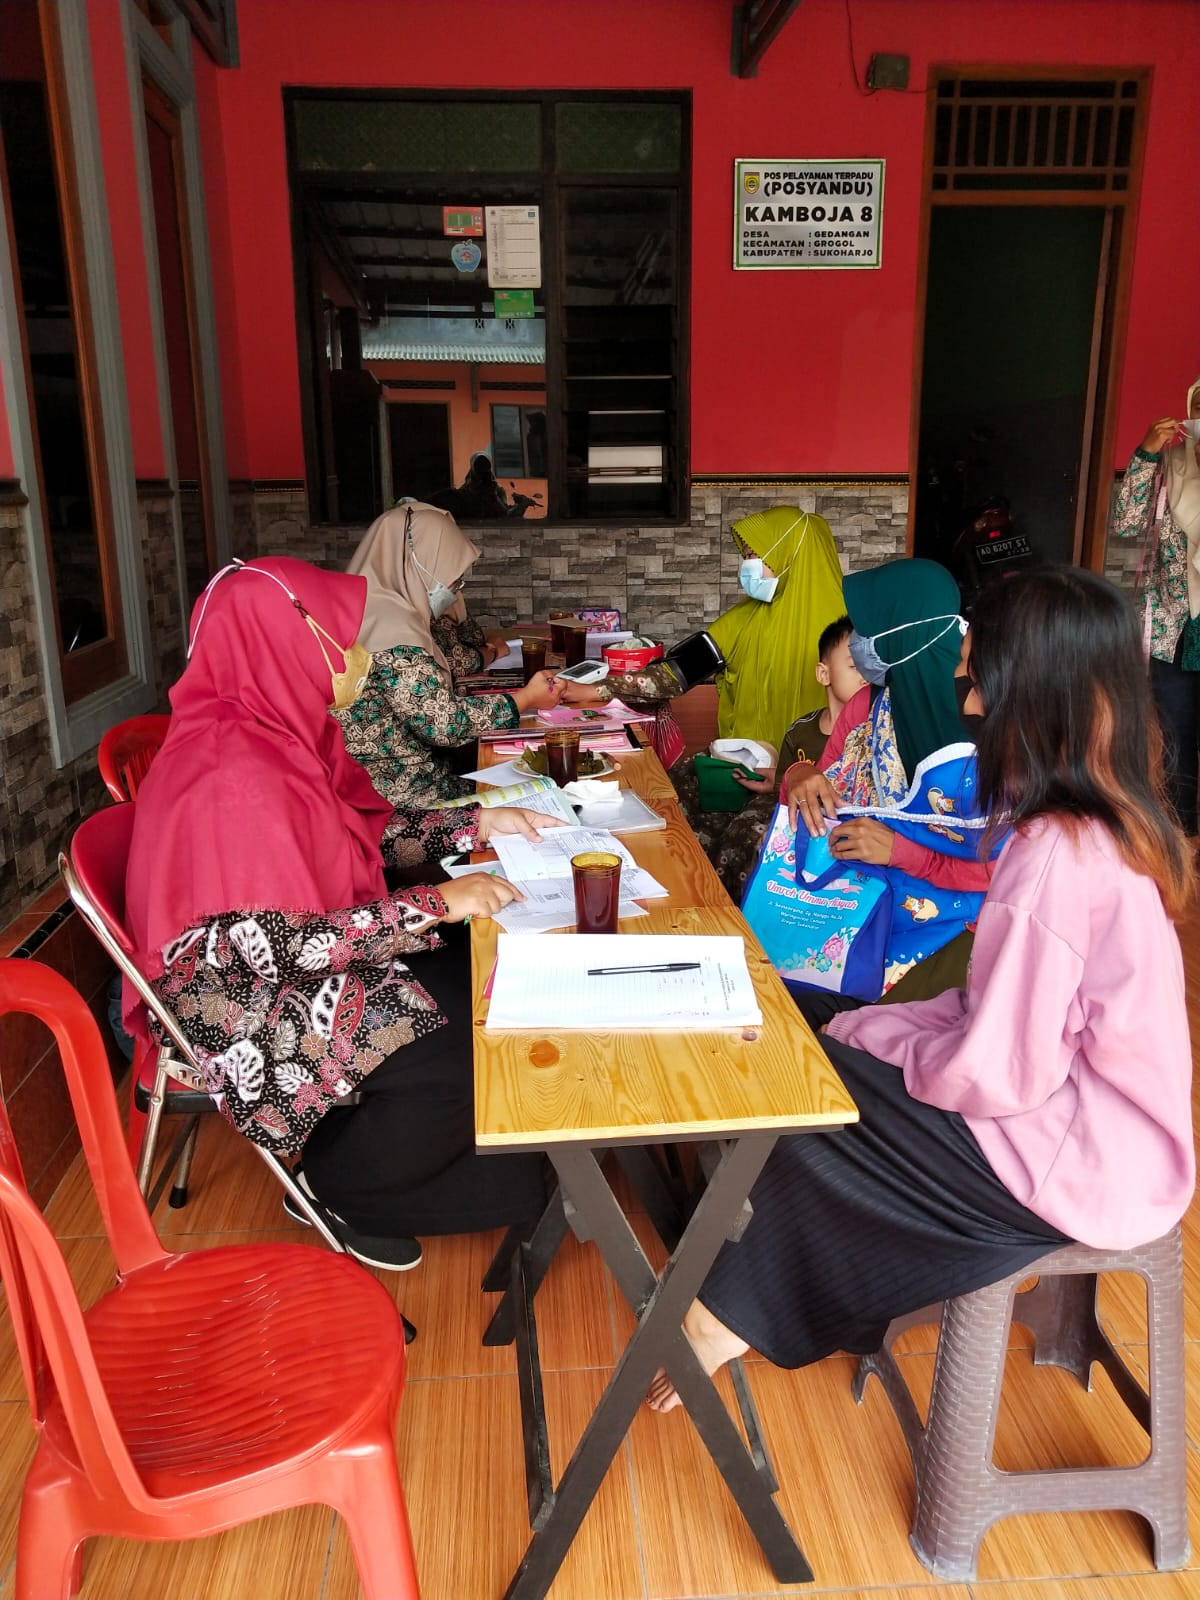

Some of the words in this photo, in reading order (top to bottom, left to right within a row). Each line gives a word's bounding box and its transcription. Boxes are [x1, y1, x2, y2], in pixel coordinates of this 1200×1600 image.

[764, 172, 781, 180] POS
[782, 172, 833, 180] PELAYANAN
[835, 172, 873, 180] TERPADU
[764, 181, 873, 197] (POSYANDU)
[745, 206, 854, 222] KAMBOJA
[860, 206, 873, 222] 8
[743, 249, 803, 257] KABUPATEN
[813, 249, 873, 257] SUKOHARJO
[767, 880, 796, 899] Umroh
